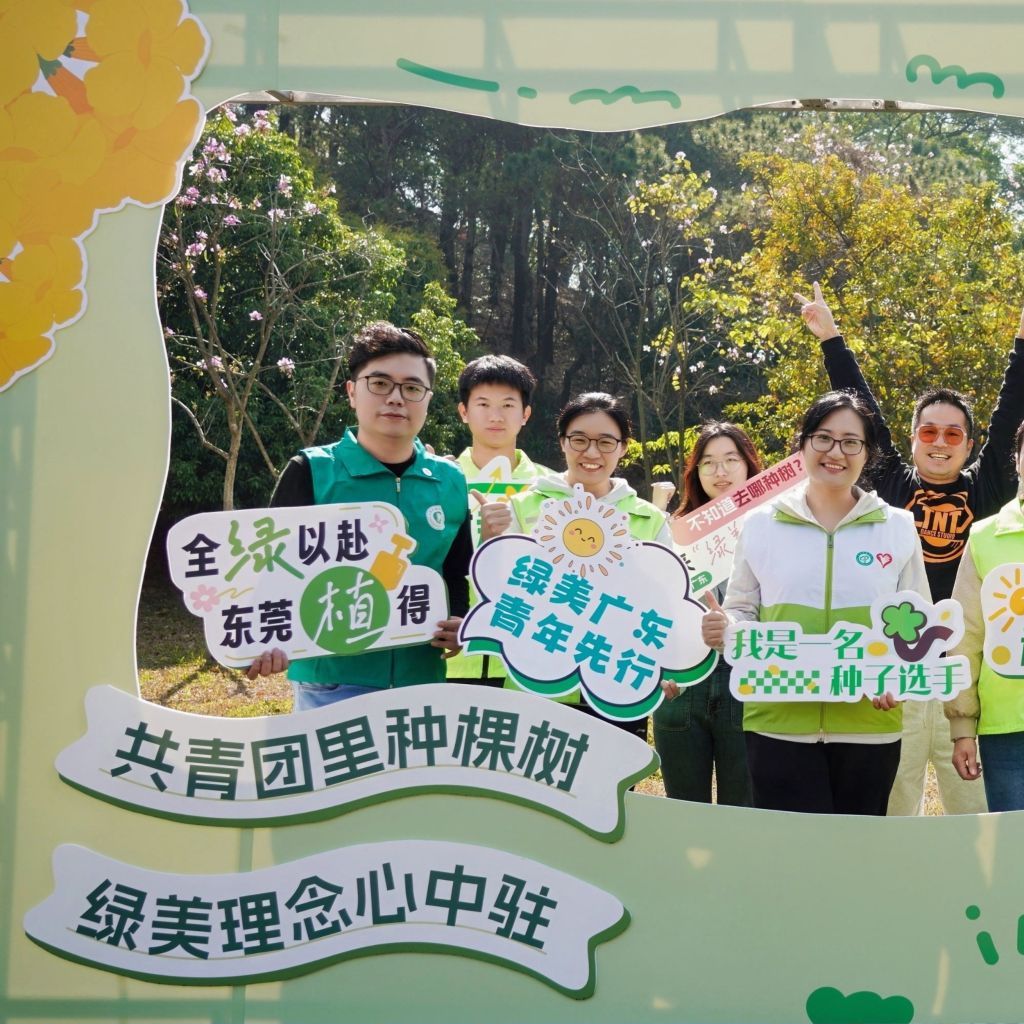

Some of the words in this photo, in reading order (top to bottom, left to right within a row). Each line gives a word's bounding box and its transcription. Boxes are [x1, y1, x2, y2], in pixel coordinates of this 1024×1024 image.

[181, 516, 370, 582] 全绿以赴
[921, 504, 962, 534] TNT
[489, 592, 657, 691] 青年先行
[507, 555, 674, 650] 绿美广东
[730, 628, 865, 661] 我是一名
[829, 662, 966, 697] 种子选手
[110, 705, 590, 801] 共青团里种棵树
[75, 862, 558, 960] 绿美理念心中驻
